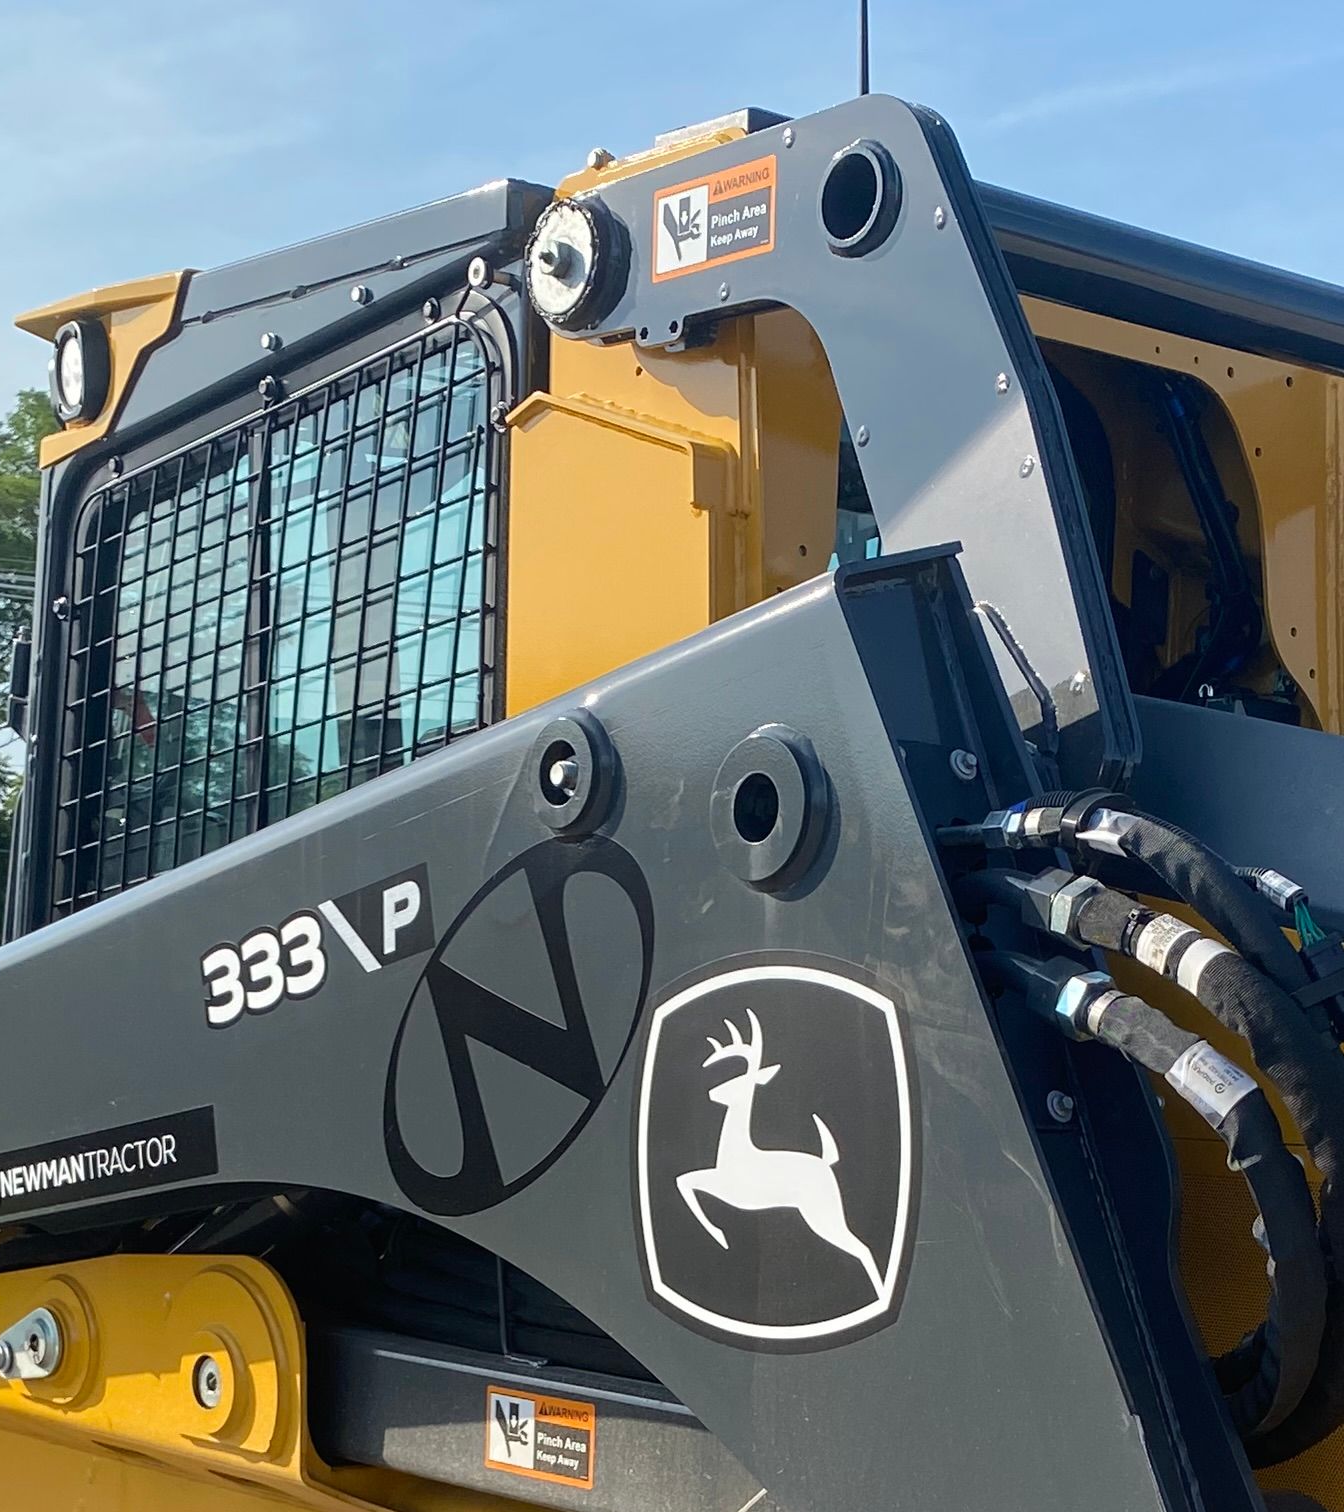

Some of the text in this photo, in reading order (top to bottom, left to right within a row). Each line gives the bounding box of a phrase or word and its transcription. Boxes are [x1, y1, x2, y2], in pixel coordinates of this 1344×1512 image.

[723, 167, 770, 192] WARNING
[711, 202, 767, 229] Pinch Area
[710, 225, 759, 247] Keep Away
[202, 915, 327, 1025] 333
[0, 1134, 177, 1198] NEWMANTRACTOR
[548, 1404, 589, 1422] WARNING
[537, 1432, 587, 1453] Pinch Area
[536, 1449, 579, 1470] Keep Away
